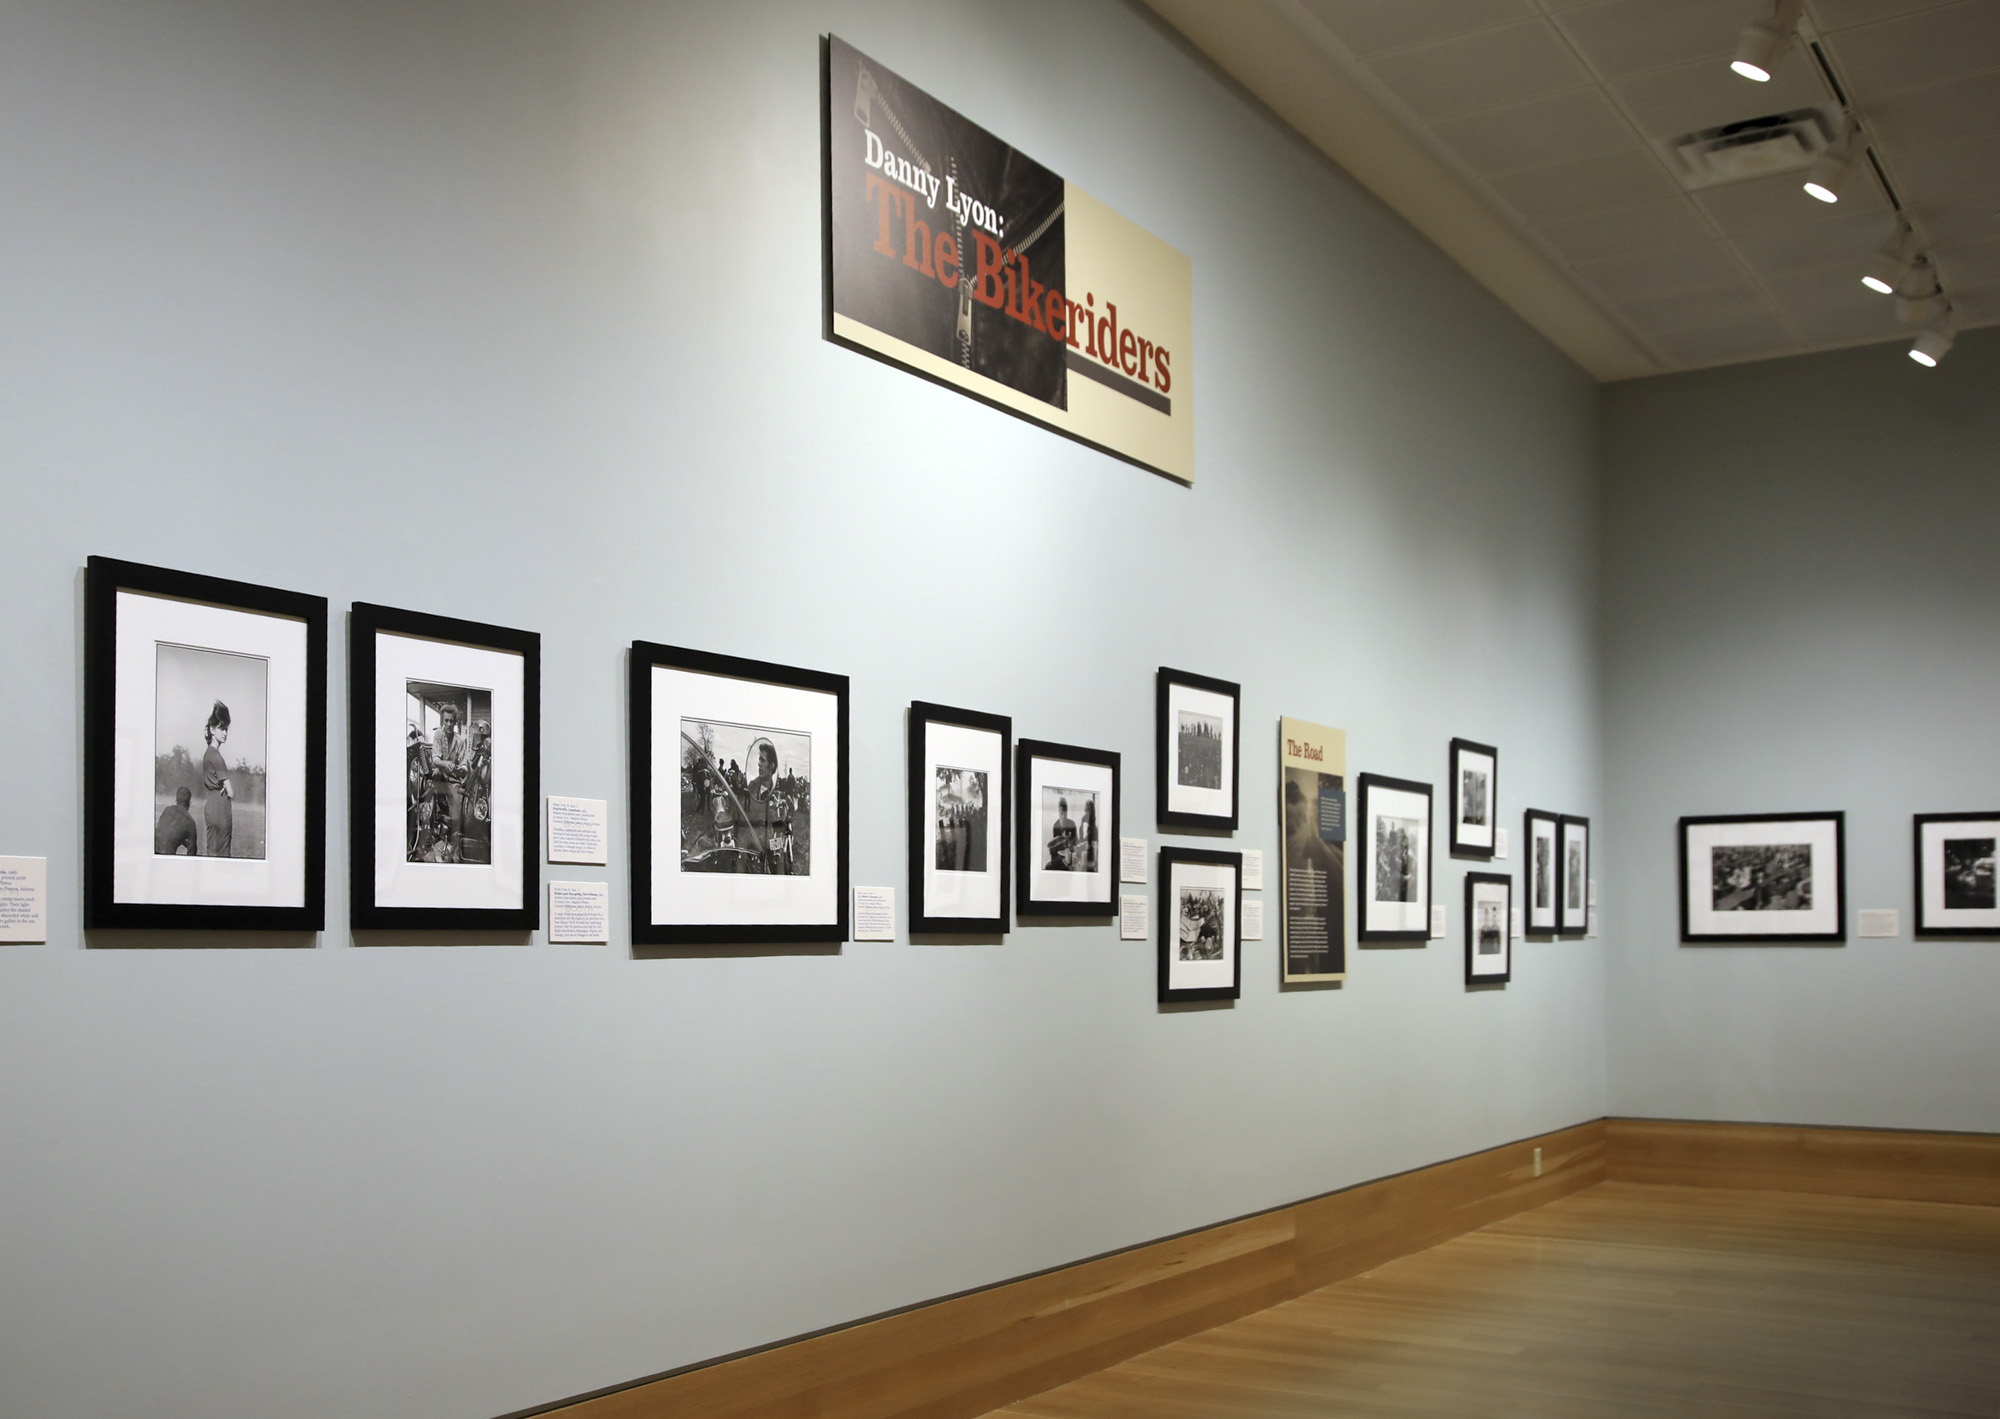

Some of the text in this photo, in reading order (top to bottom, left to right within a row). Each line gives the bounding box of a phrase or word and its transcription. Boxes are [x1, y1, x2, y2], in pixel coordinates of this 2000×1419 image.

[865, 129, 1004, 238] Danny Lyon:
[866, 171, 1171, 394] The Bikeriders
[1287, 738, 1324, 762] The Road
